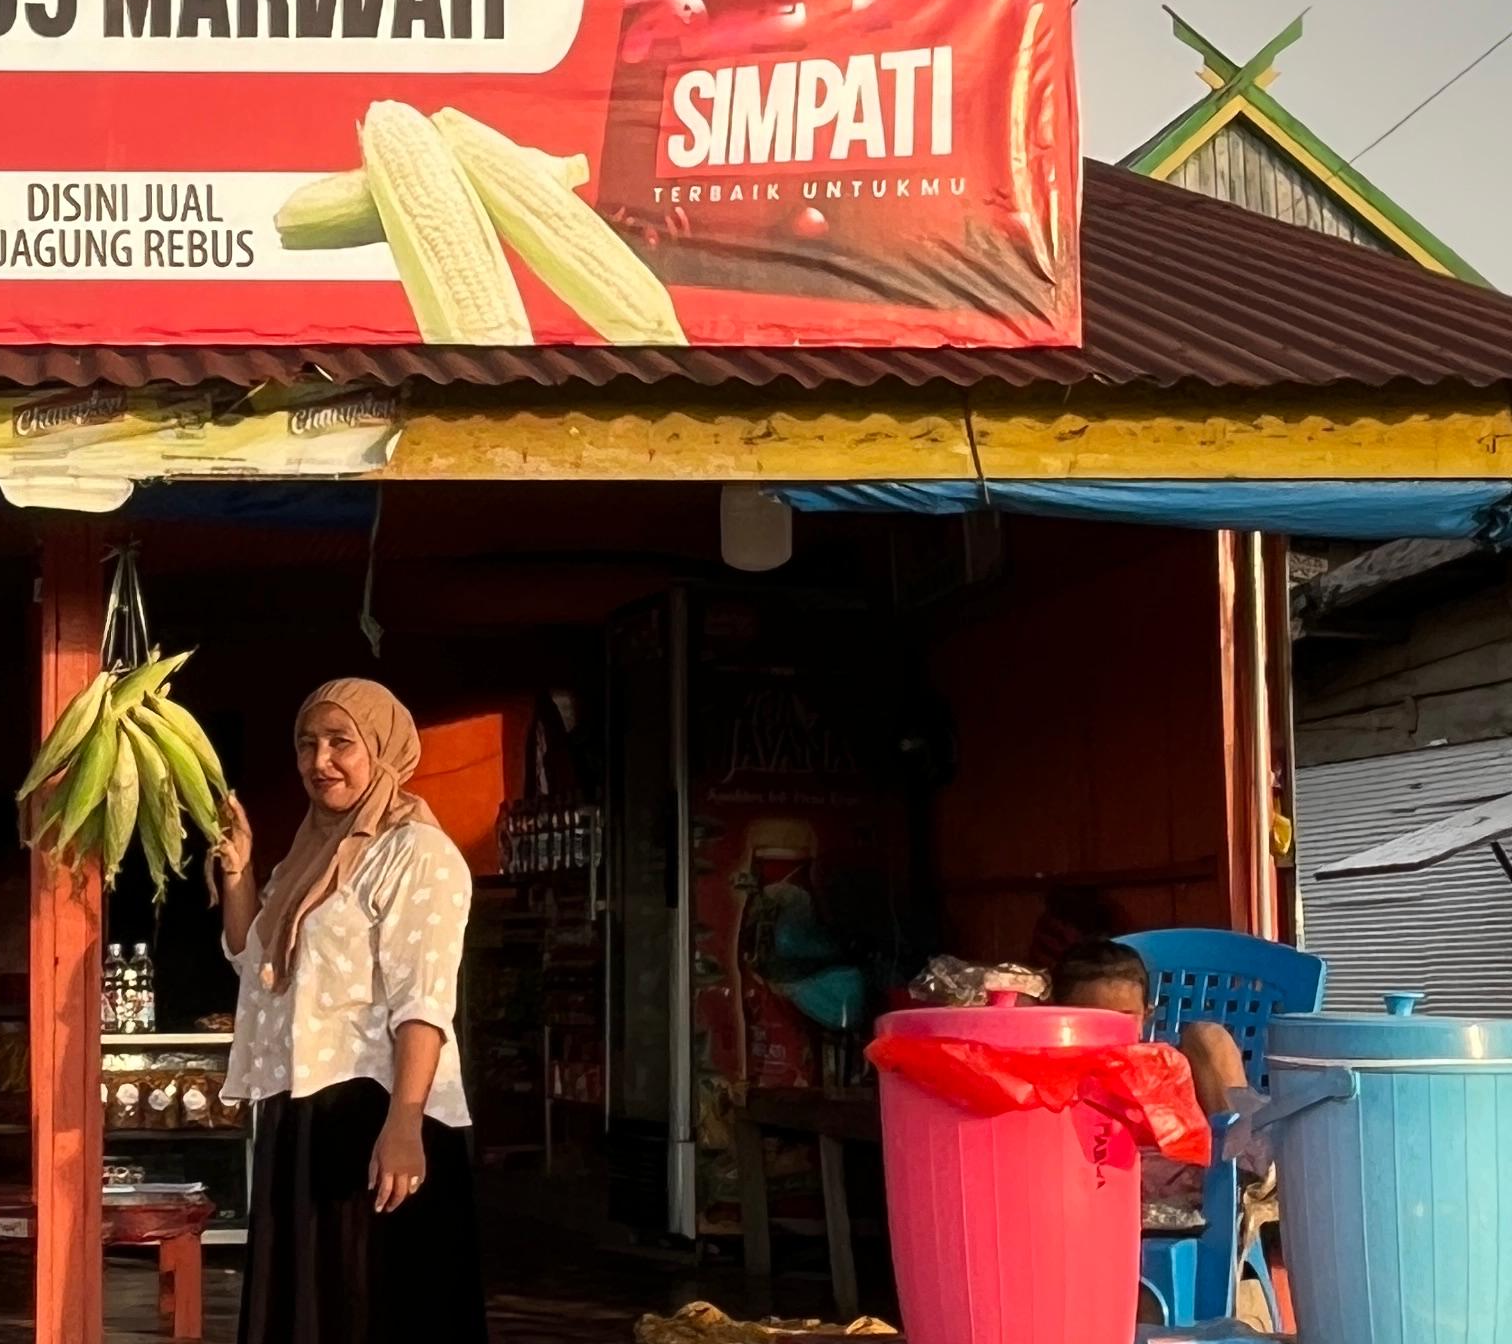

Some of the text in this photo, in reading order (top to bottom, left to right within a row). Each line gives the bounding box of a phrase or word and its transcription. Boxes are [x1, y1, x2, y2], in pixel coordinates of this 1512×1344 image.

[667, 45, 953, 169] SIMPATI
[26, 182, 224, 224] DISINI JUAL
[653, 177, 967, 205] TERBAIK UNTUKMU
[144, 229, 255, 269] REBUS
